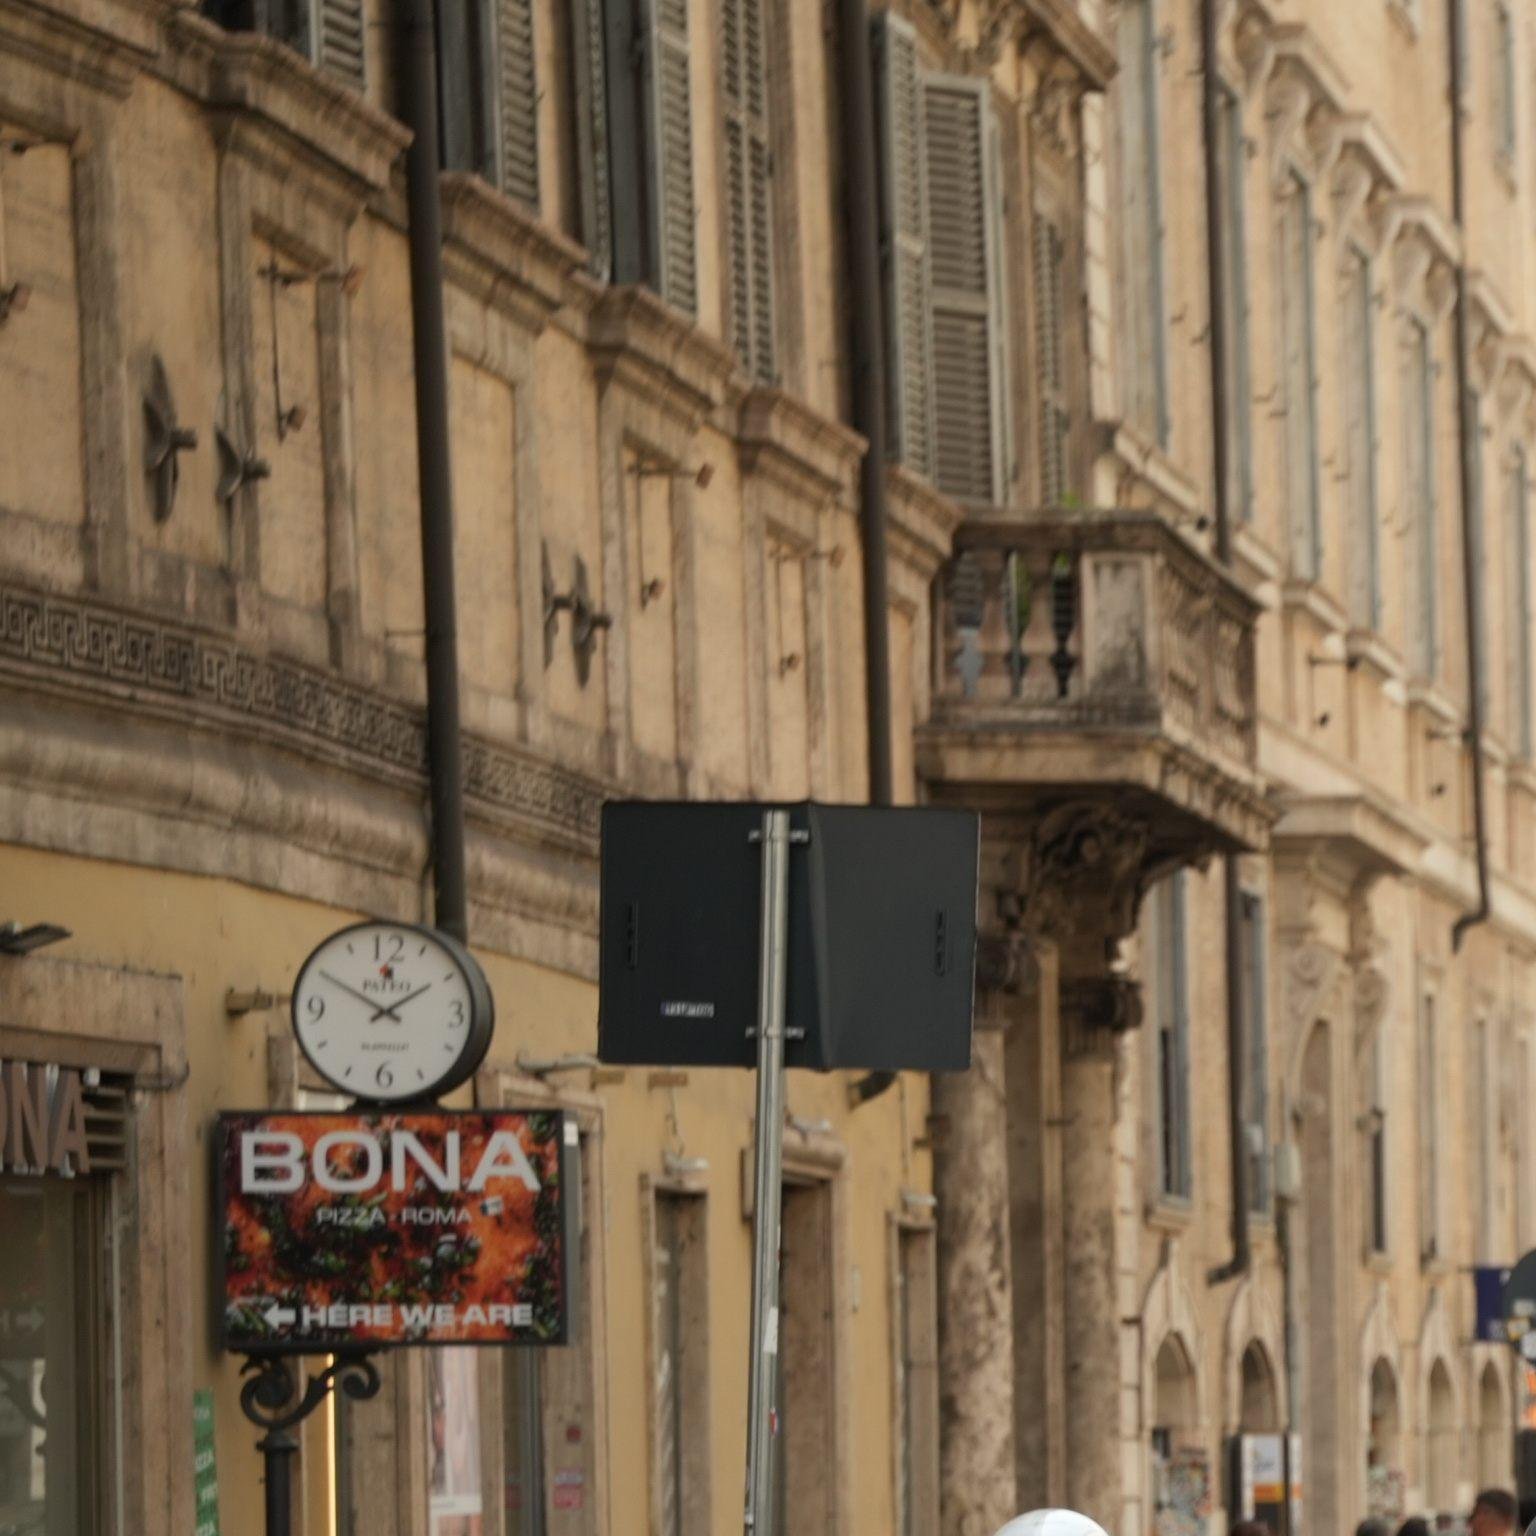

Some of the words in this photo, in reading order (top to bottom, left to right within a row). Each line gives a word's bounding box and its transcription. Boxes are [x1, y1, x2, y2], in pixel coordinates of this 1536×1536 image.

[373, 934, 404, 961] 12
[307, 996, 325, 1023] 9
[449, 1001, 463, 1028] 3
[376, 1060, 393, 1088] 6
[241, 1130, 541, 1193] BONA
[317, 1206, 386, 1227] PIZZA
[402, 1206, 472, 1225] ROMA
[302, 1303, 392, 1327] HERE
[400, 1303, 456, 1327] WE
[462, 1303, 533, 1327] ARE
